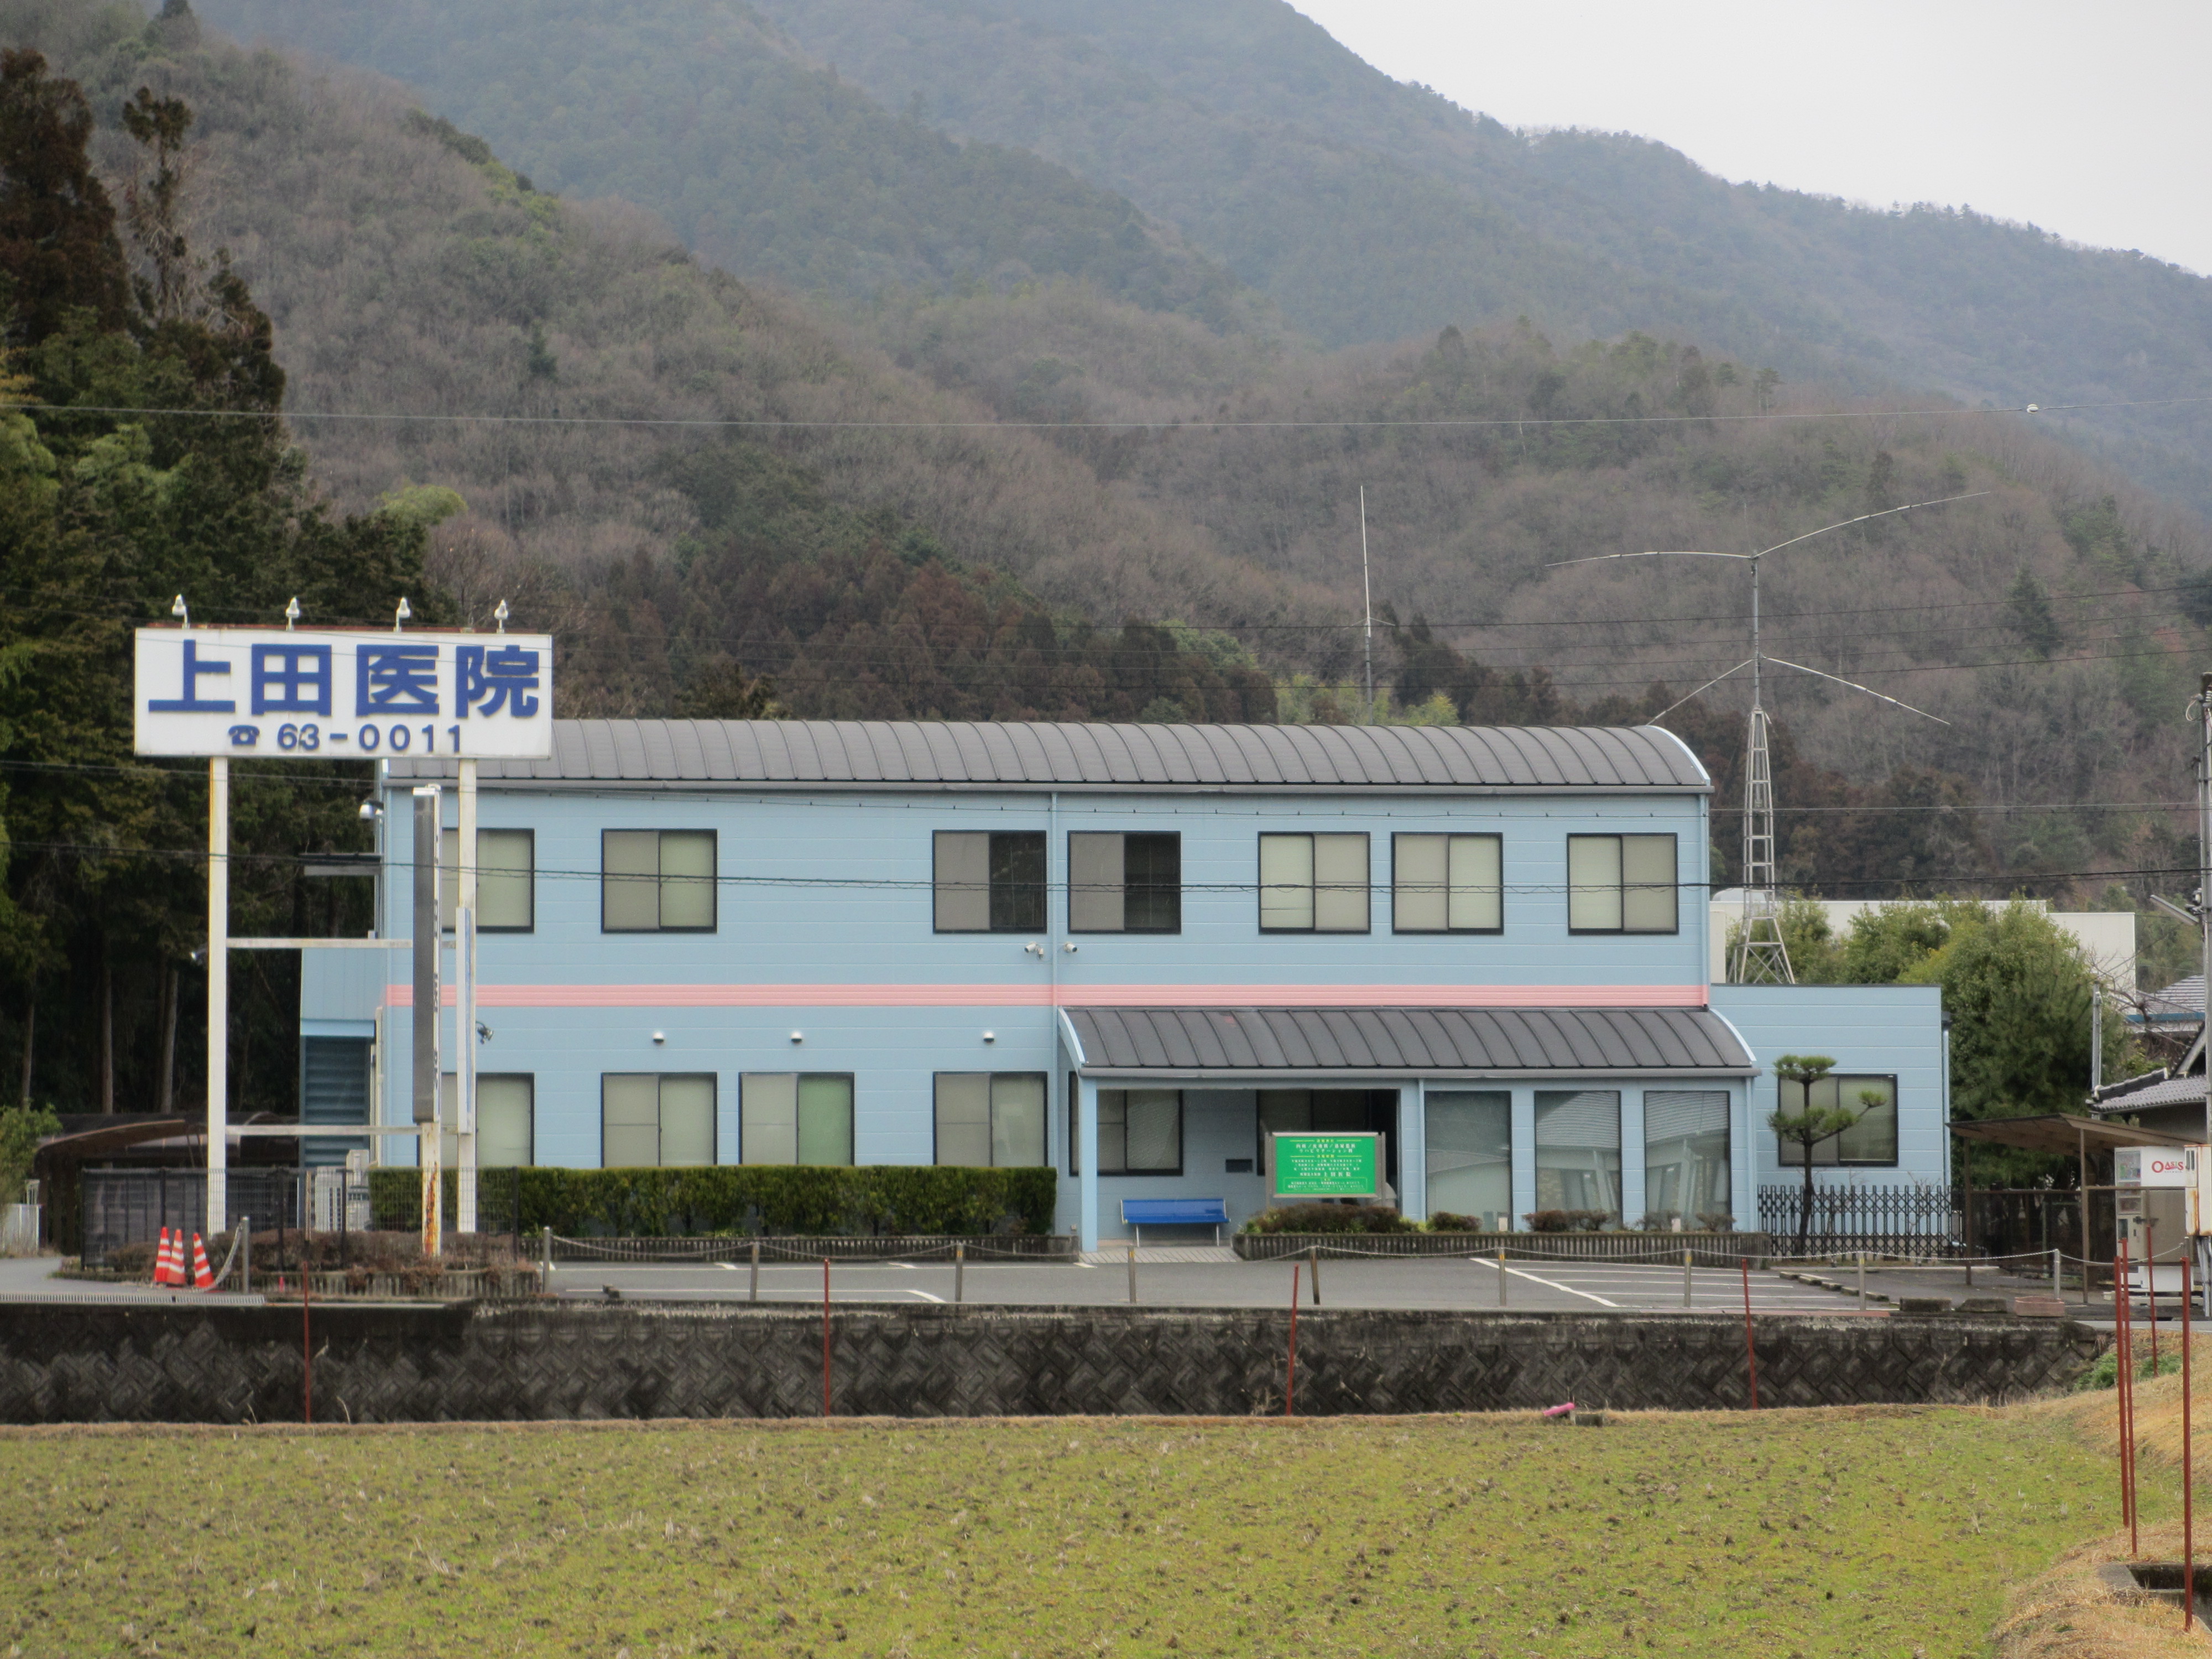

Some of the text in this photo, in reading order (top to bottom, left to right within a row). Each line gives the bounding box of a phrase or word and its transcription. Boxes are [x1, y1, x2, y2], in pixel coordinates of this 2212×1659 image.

[148, 639, 539, 718] 上田医院
[277, 723, 461, 753] 63-0011
[2152, 1161, 2183, 1173] OASIS
